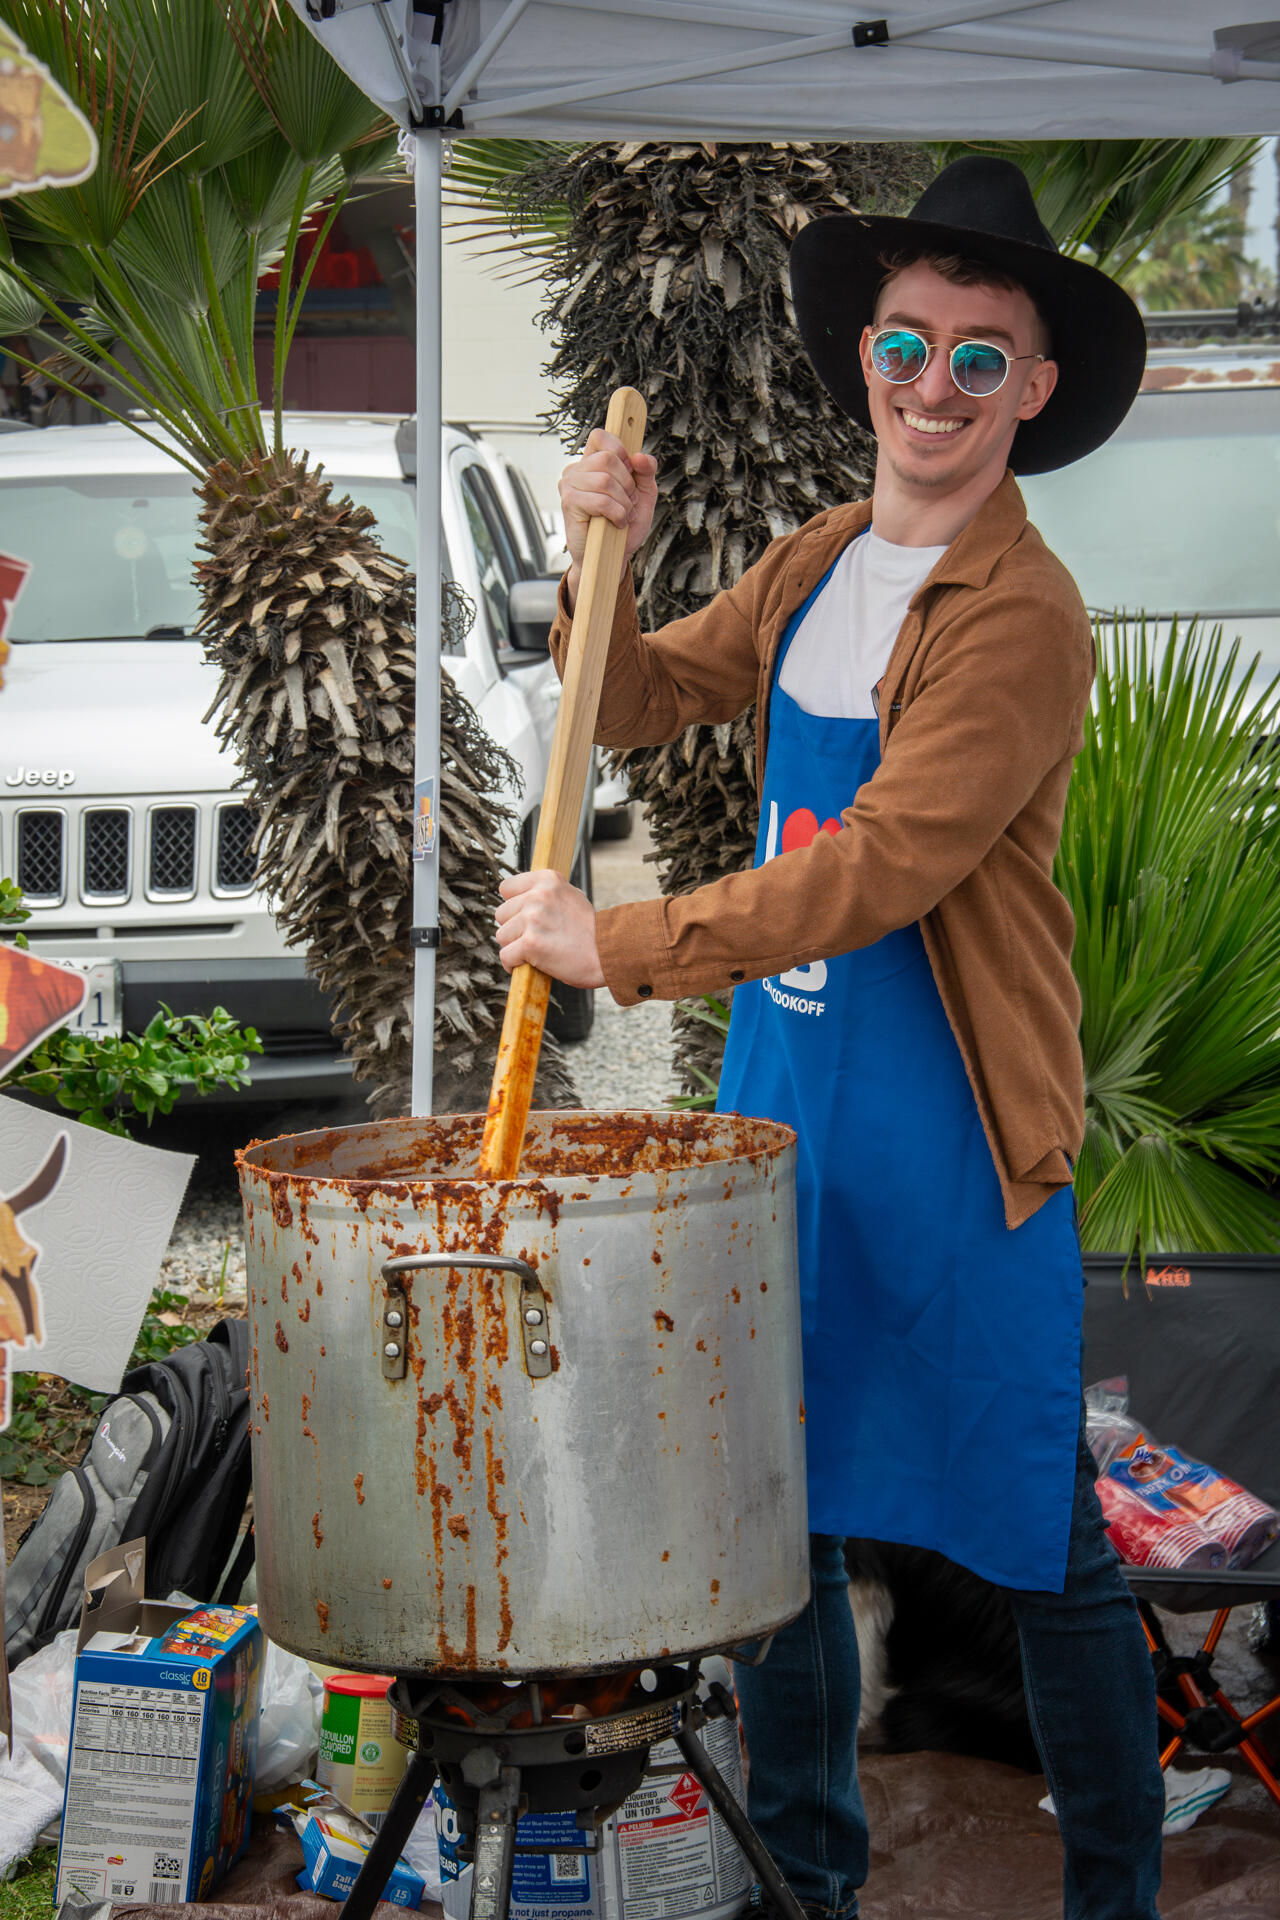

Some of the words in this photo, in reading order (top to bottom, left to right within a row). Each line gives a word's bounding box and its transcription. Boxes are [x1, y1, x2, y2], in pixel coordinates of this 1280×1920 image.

[5, 766, 75, 790] Jeep
[160, 1670, 191, 1683] classic
[197, 1671, 208, 1683] 18
[655, 1796, 668, 1805] GAS
[625, 1809, 637, 1819] UN
[640, 1806, 661, 1817] 1075
[686, 1803, 691, 1812] 2
[335, 1873, 351, 1884] Tall
[332, 1880, 352, 1892] Bags
[395, 1889, 408, 1900] 15
[515, 1908, 530, 1916] not
[532, 1909, 549, 1918] just
[551, 1908, 594, 1918] propane.
